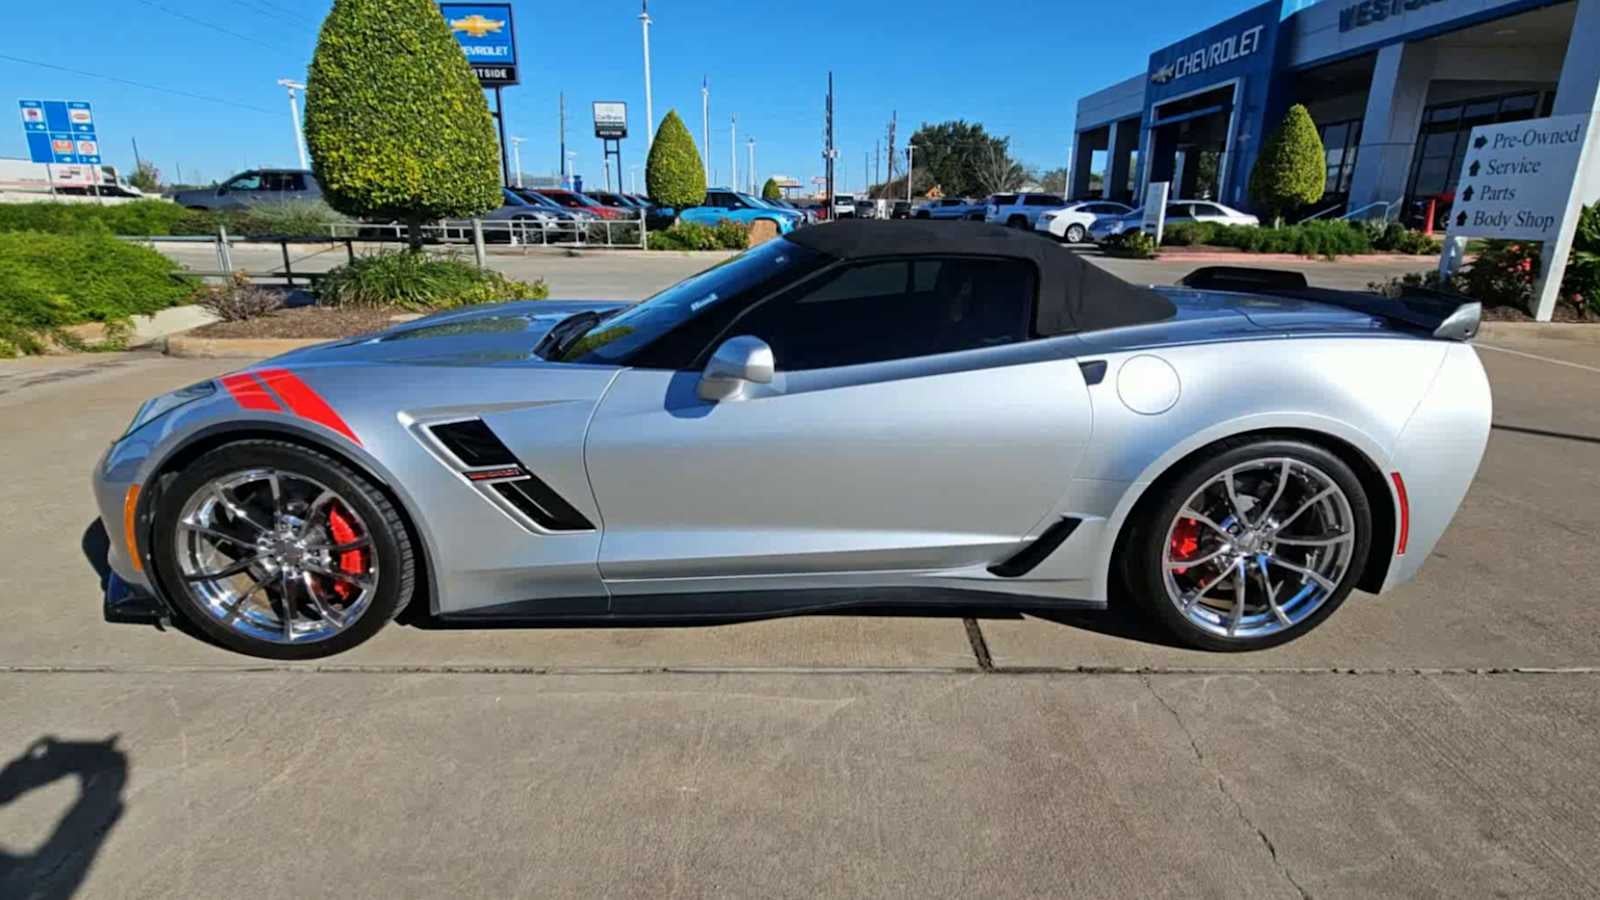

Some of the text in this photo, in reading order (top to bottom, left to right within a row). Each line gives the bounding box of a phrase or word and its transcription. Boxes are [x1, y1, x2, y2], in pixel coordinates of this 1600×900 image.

[462, 46, 508, 56] EVROLET
[1175, 25, 1264, 79] CHEVROLET
[1493, 124, 1580, 149] Pre-Owned
[1486, 157, 1541, 175] Service
[1481, 185, 1517, 200] Parts
[1473, 210, 1555, 232] Body Shop
